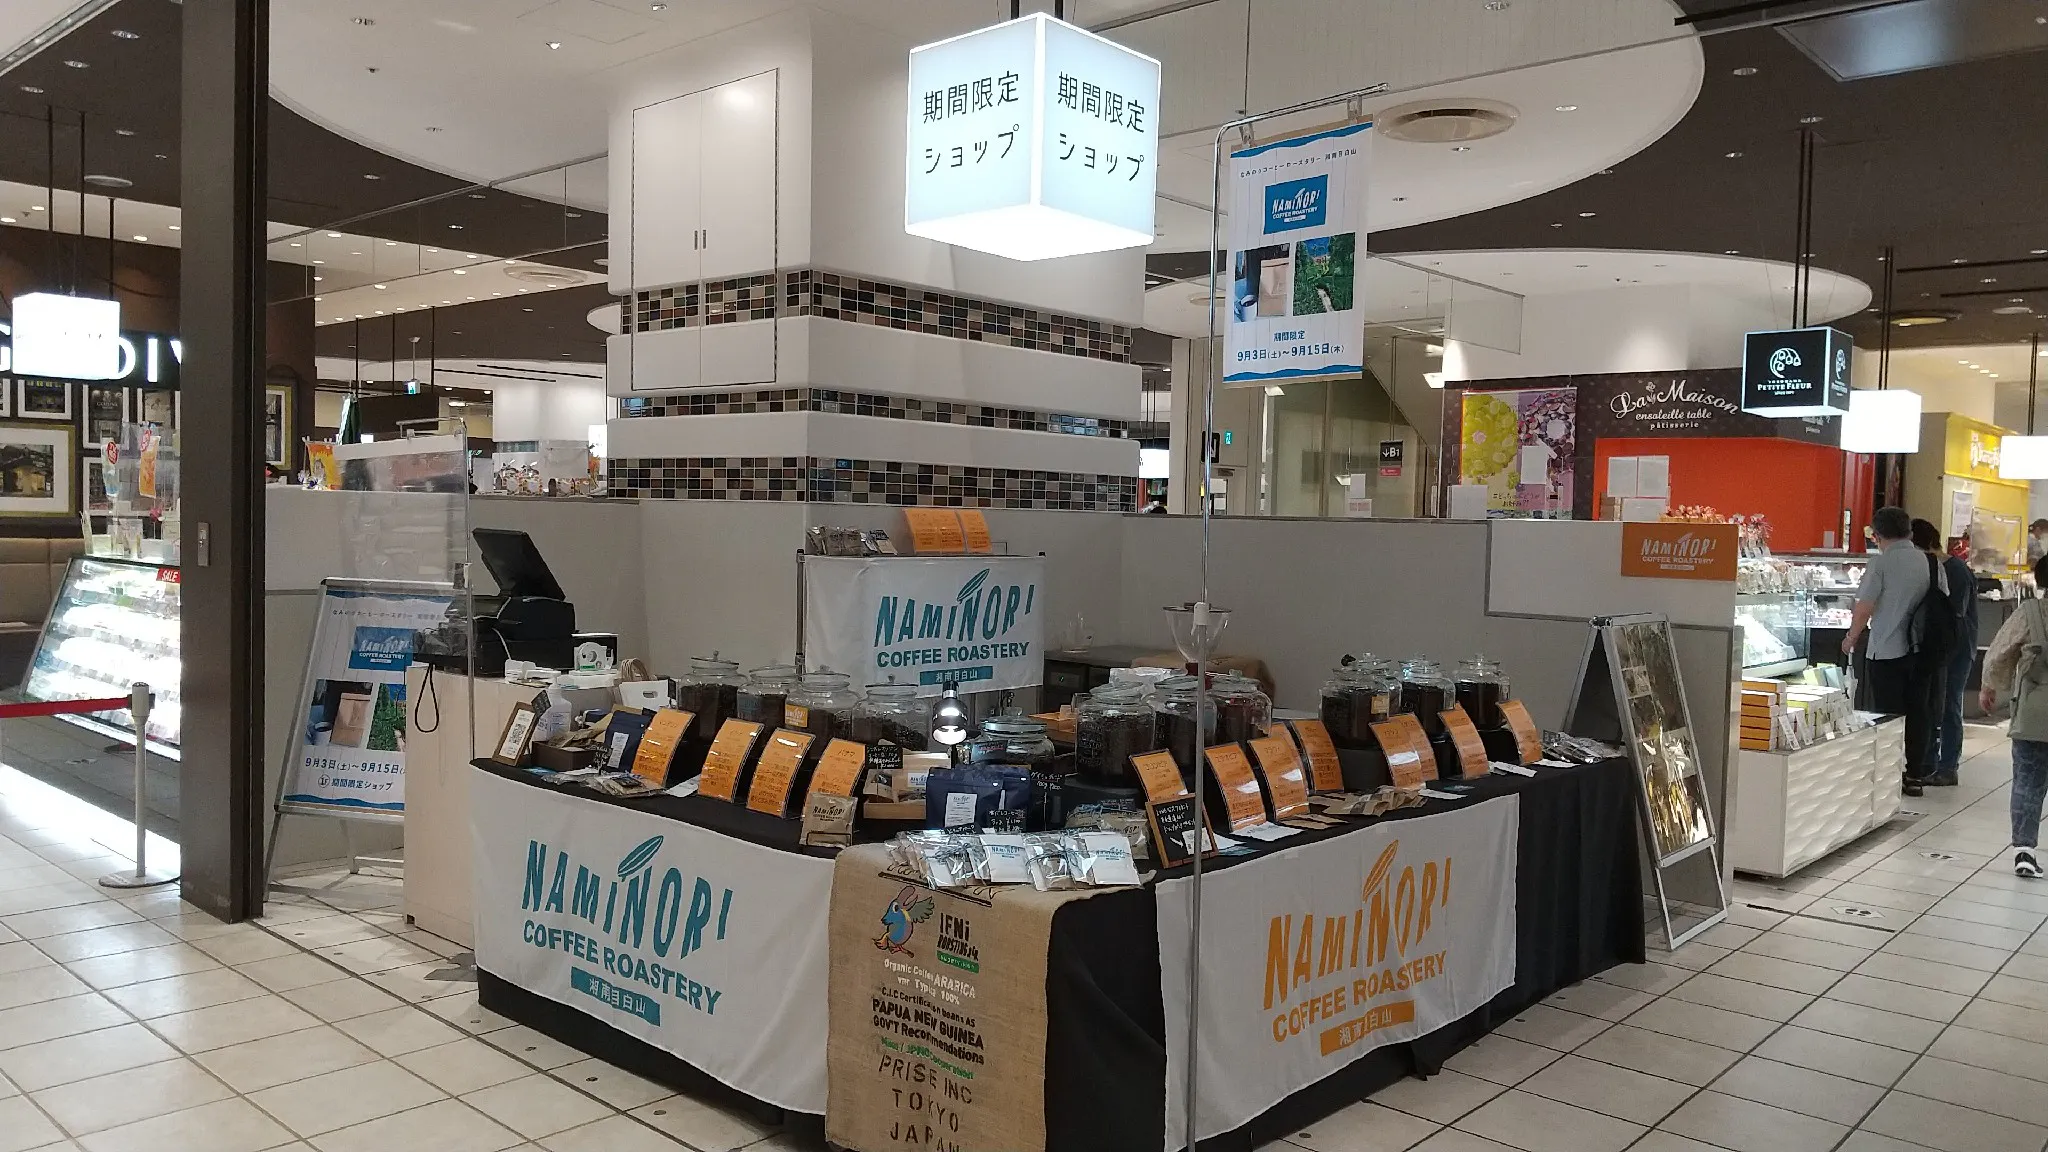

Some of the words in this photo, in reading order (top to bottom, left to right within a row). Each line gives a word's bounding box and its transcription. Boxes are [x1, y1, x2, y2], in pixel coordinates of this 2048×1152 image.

[922, 70, 1019, 124] 期間限定
[1057, 71, 1145, 133] 期間限定
[925, 123, 1020, 174] ショップ
[1059, 132, 1145, 181] ショップ
[1271, 189, 1321, 214] NAMINORI
[1273, 330, 1306, 342] 期間限定
[1610, 391, 1648, 419] La
[1656, 379, 1739, 415] Maison
[1757, 383, 1786, 391] PETITE
[1786, 382, 1813, 390] FLEUR
[1686, 408, 1712, 420] table
[1389, 447, 1400, 458] B1
[1641, 537, 1717, 557] NAMINORI
[161, 570, 178, 582] SALE
[873, 584, 1035, 648] NAMINORI
[876, 650, 942, 669] COFFEE
[947, 641, 1030, 663] ROASTERY
[521, 839, 734, 961] NAMINORI
[1263, 857, 1452, 1011] NAMINORI
[523, 919, 599, 964] COFFEE
[603, 946, 723, 1016] ROASTERY
[884, 958, 912, 974] Organic
[589, 977, 646, 1015] 湘南目白山
[940, 989, 960, 1006] 100%
[1272, 985, 1347, 1043] COFFEE
[1352, 949, 1447, 1006] ROASTERY
[872, 998, 911, 1022] PAPUA
[914, 1008, 938, 1030] NEW
[939, 1020, 984, 1050] GUINEA
[878, 1054, 938, 1089] PRISE
[943, 1077, 973, 1104] INC
[891, 1088, 959, 1133] TOKYO
